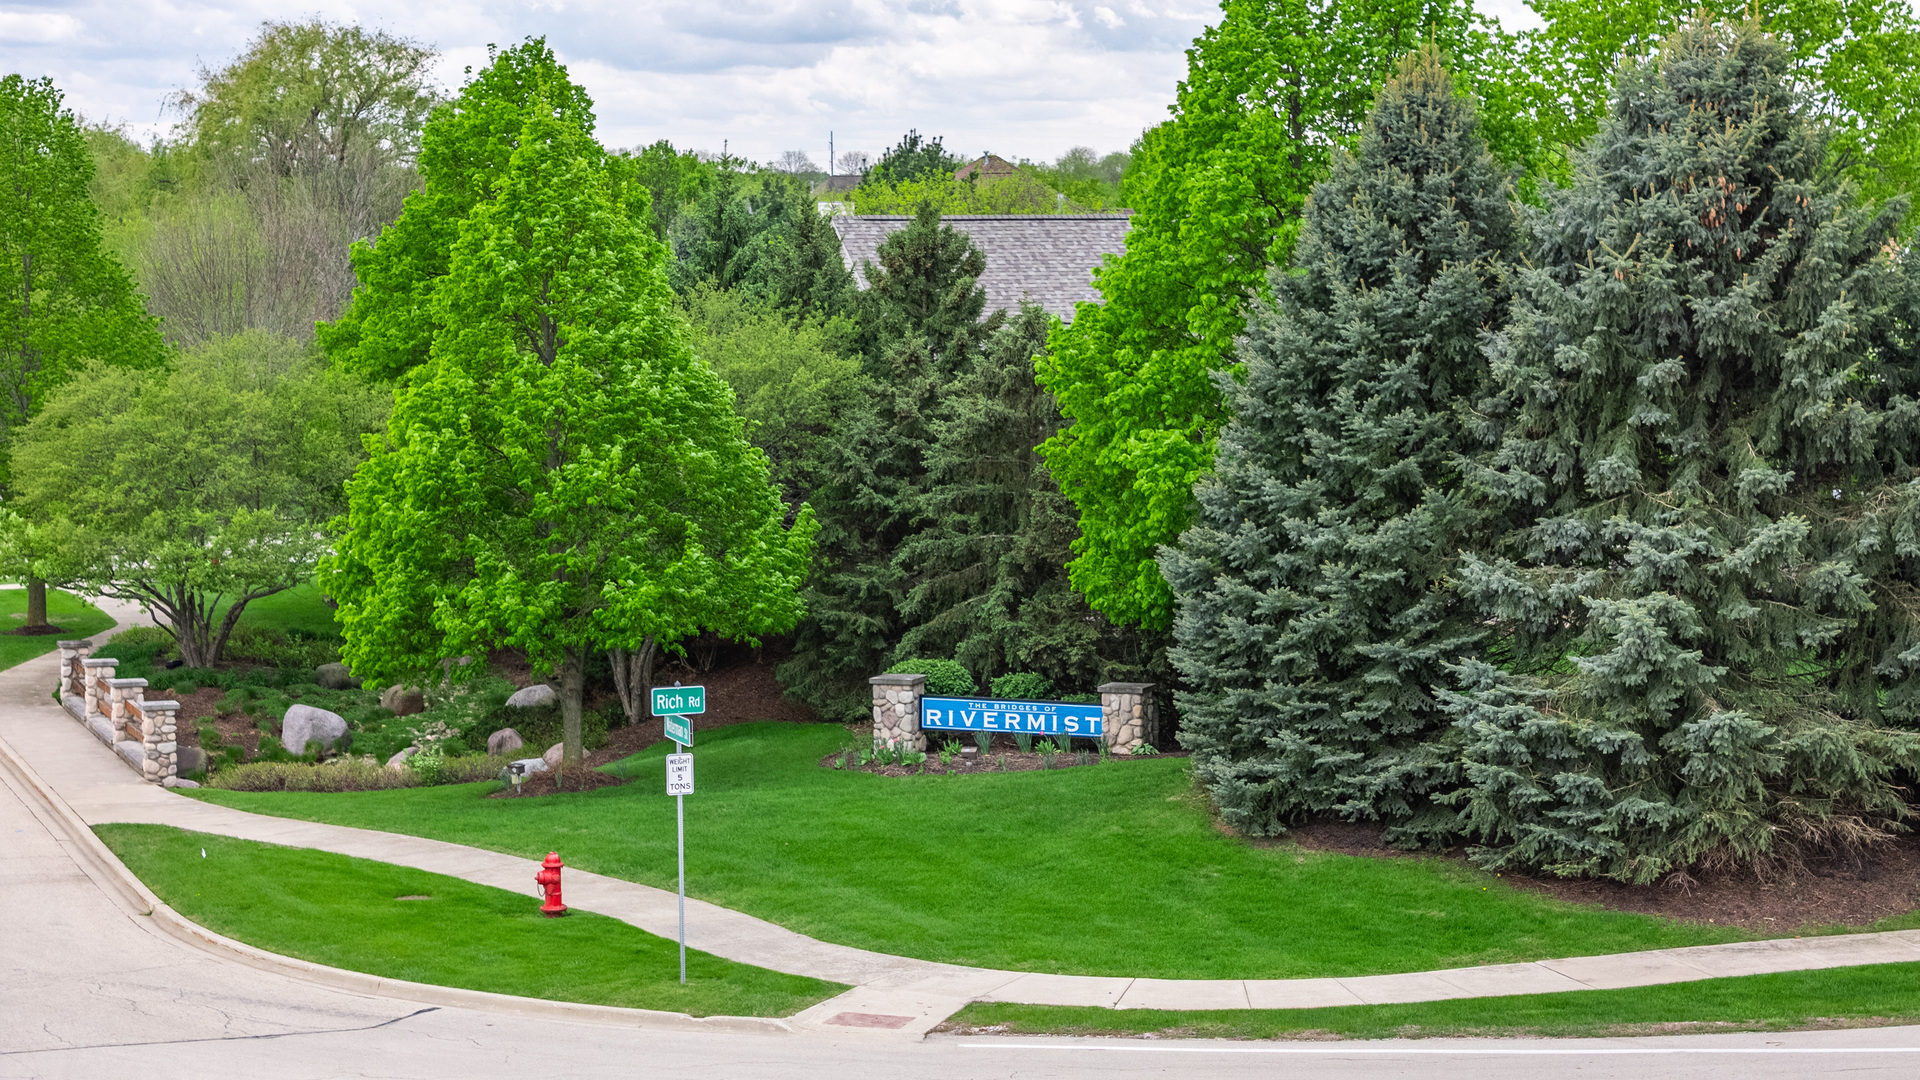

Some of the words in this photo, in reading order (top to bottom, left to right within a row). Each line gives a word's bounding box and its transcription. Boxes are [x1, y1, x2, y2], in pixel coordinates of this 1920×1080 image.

[657, 694, 683, 709] Rich
[688, 696, 700, 707] Rd
[993, 703, 1038, 712] BRIDGES
[926, 709, 1101, 733] RIVERMIST
